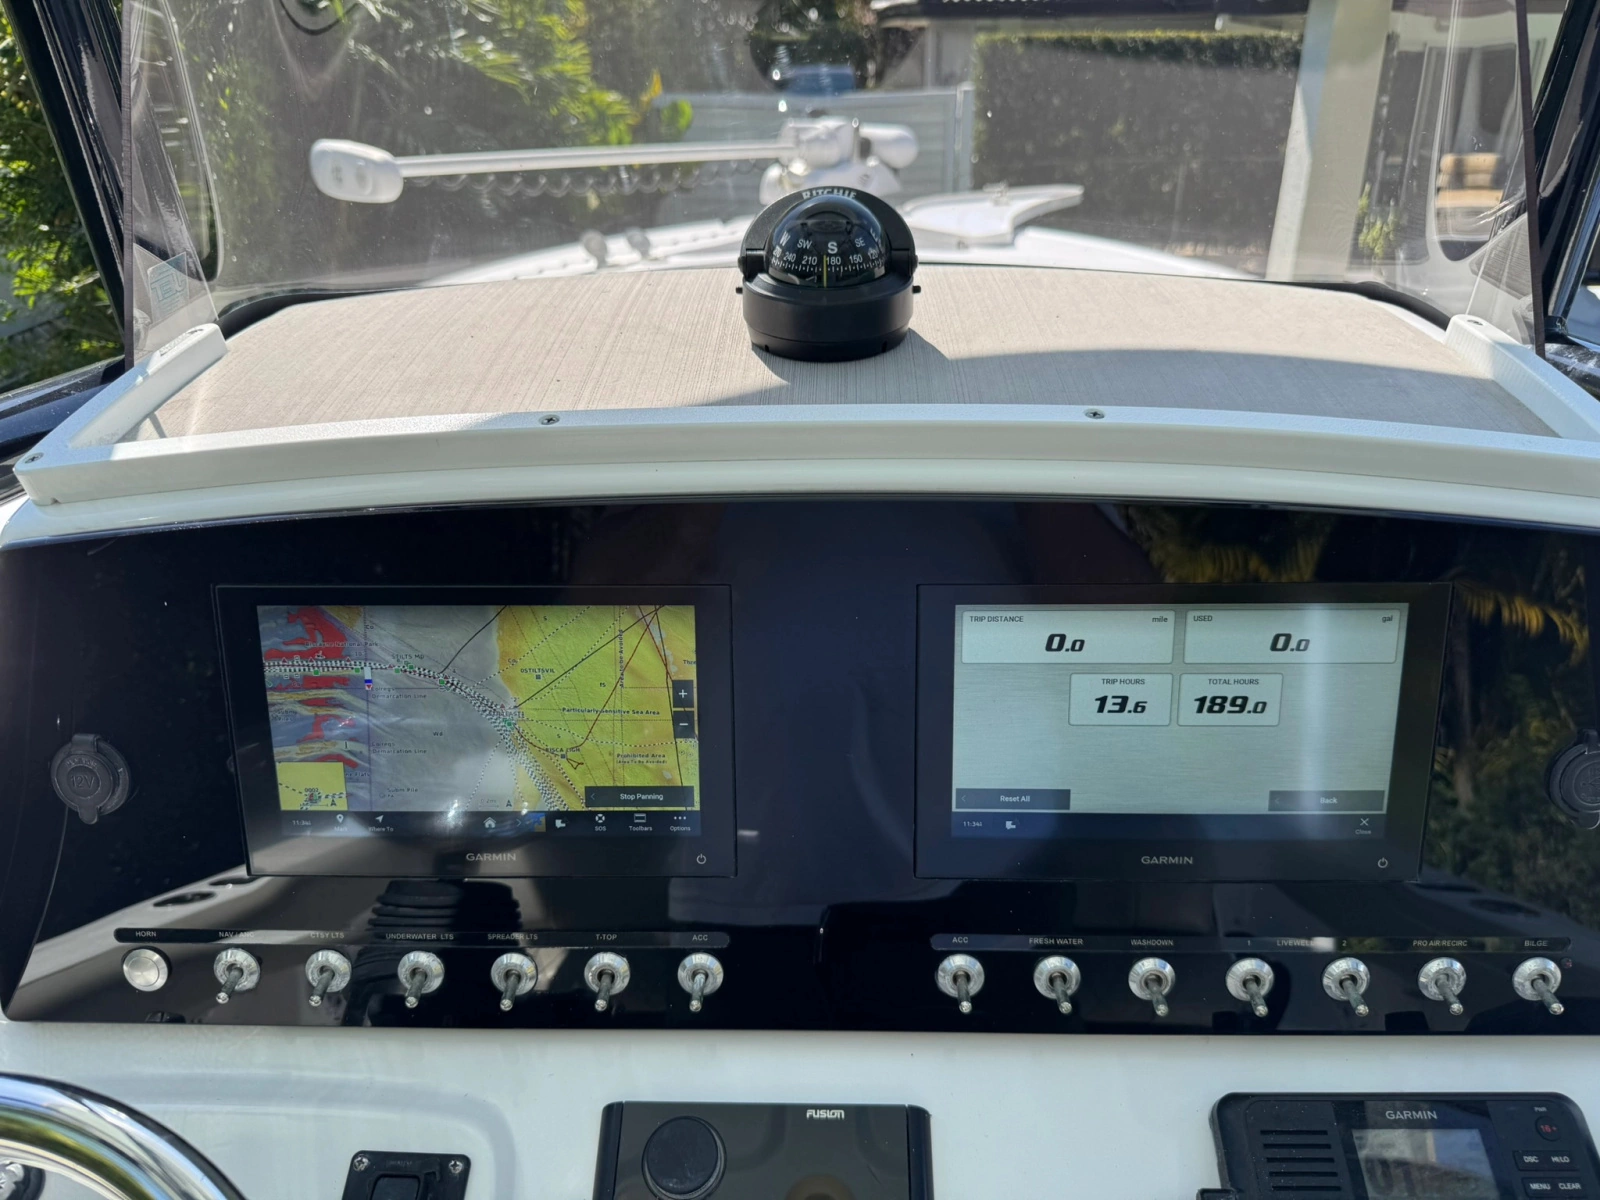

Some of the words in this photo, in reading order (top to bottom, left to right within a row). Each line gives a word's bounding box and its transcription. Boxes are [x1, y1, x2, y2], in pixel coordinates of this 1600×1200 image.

[801, 187, 857, 200] RITCHIE
[779, 230, 790, 247] W
[855, 238, 866, 248] SE
[797, 239, 812, 249] SW
[827, 241, 838, 254] S
[783, 252, 796, 263] 240
[802, 255, 818, 265] 210
[826, 256, 841, 265] 180
[849, 254, 863, 264] 150
[969, 615, 986, 623] TRIP
[987, 615, 1024, 623] DISTANCE
[1151, 615, 1168, 623] mile
[1381, 615, 1393, 623] gal
[1044, 633, 1085, 652] 0.0
[1269, 633, 1310, 652] 0.0
[1094, 695, 1148, 714] 13.6
[1193, 695, 1267, 714] 189.0
[72, 775, 95, 789] 12V
[619, 792, 635, 801] Stop
[636, 792, 664, 801] Panning
[1320, 796, 1338, 804] Back
[669, 825, 691, 833] Options
[465, 852, 517, 862] GARMIN
[1141, 855, 1194, 865] GARMIN
[595, 933, 618, 941] T-TOP
[1029, 937, 1055, 945] FRESH
[1056, 937, 1083, 945] WATER
[1130, 938, 1174, 946] WASHDOWN
[1412, 939, 1428, 947] PRO
[1429, 939, 1441, 947] AIR
[1442, 939, 1467, 947] RECIRC
[1524, 939, 1548, 947] BILGE
[806, 1109, 845, 1119] FUSION
[1385, 1110, 1438, 1120] GARMIN
[1522, 1155, 1539, 1163] DSC
[1529, 1182, 1551, 1190] MENU
[1558, 1182, 1581, 1190] CLEAR
